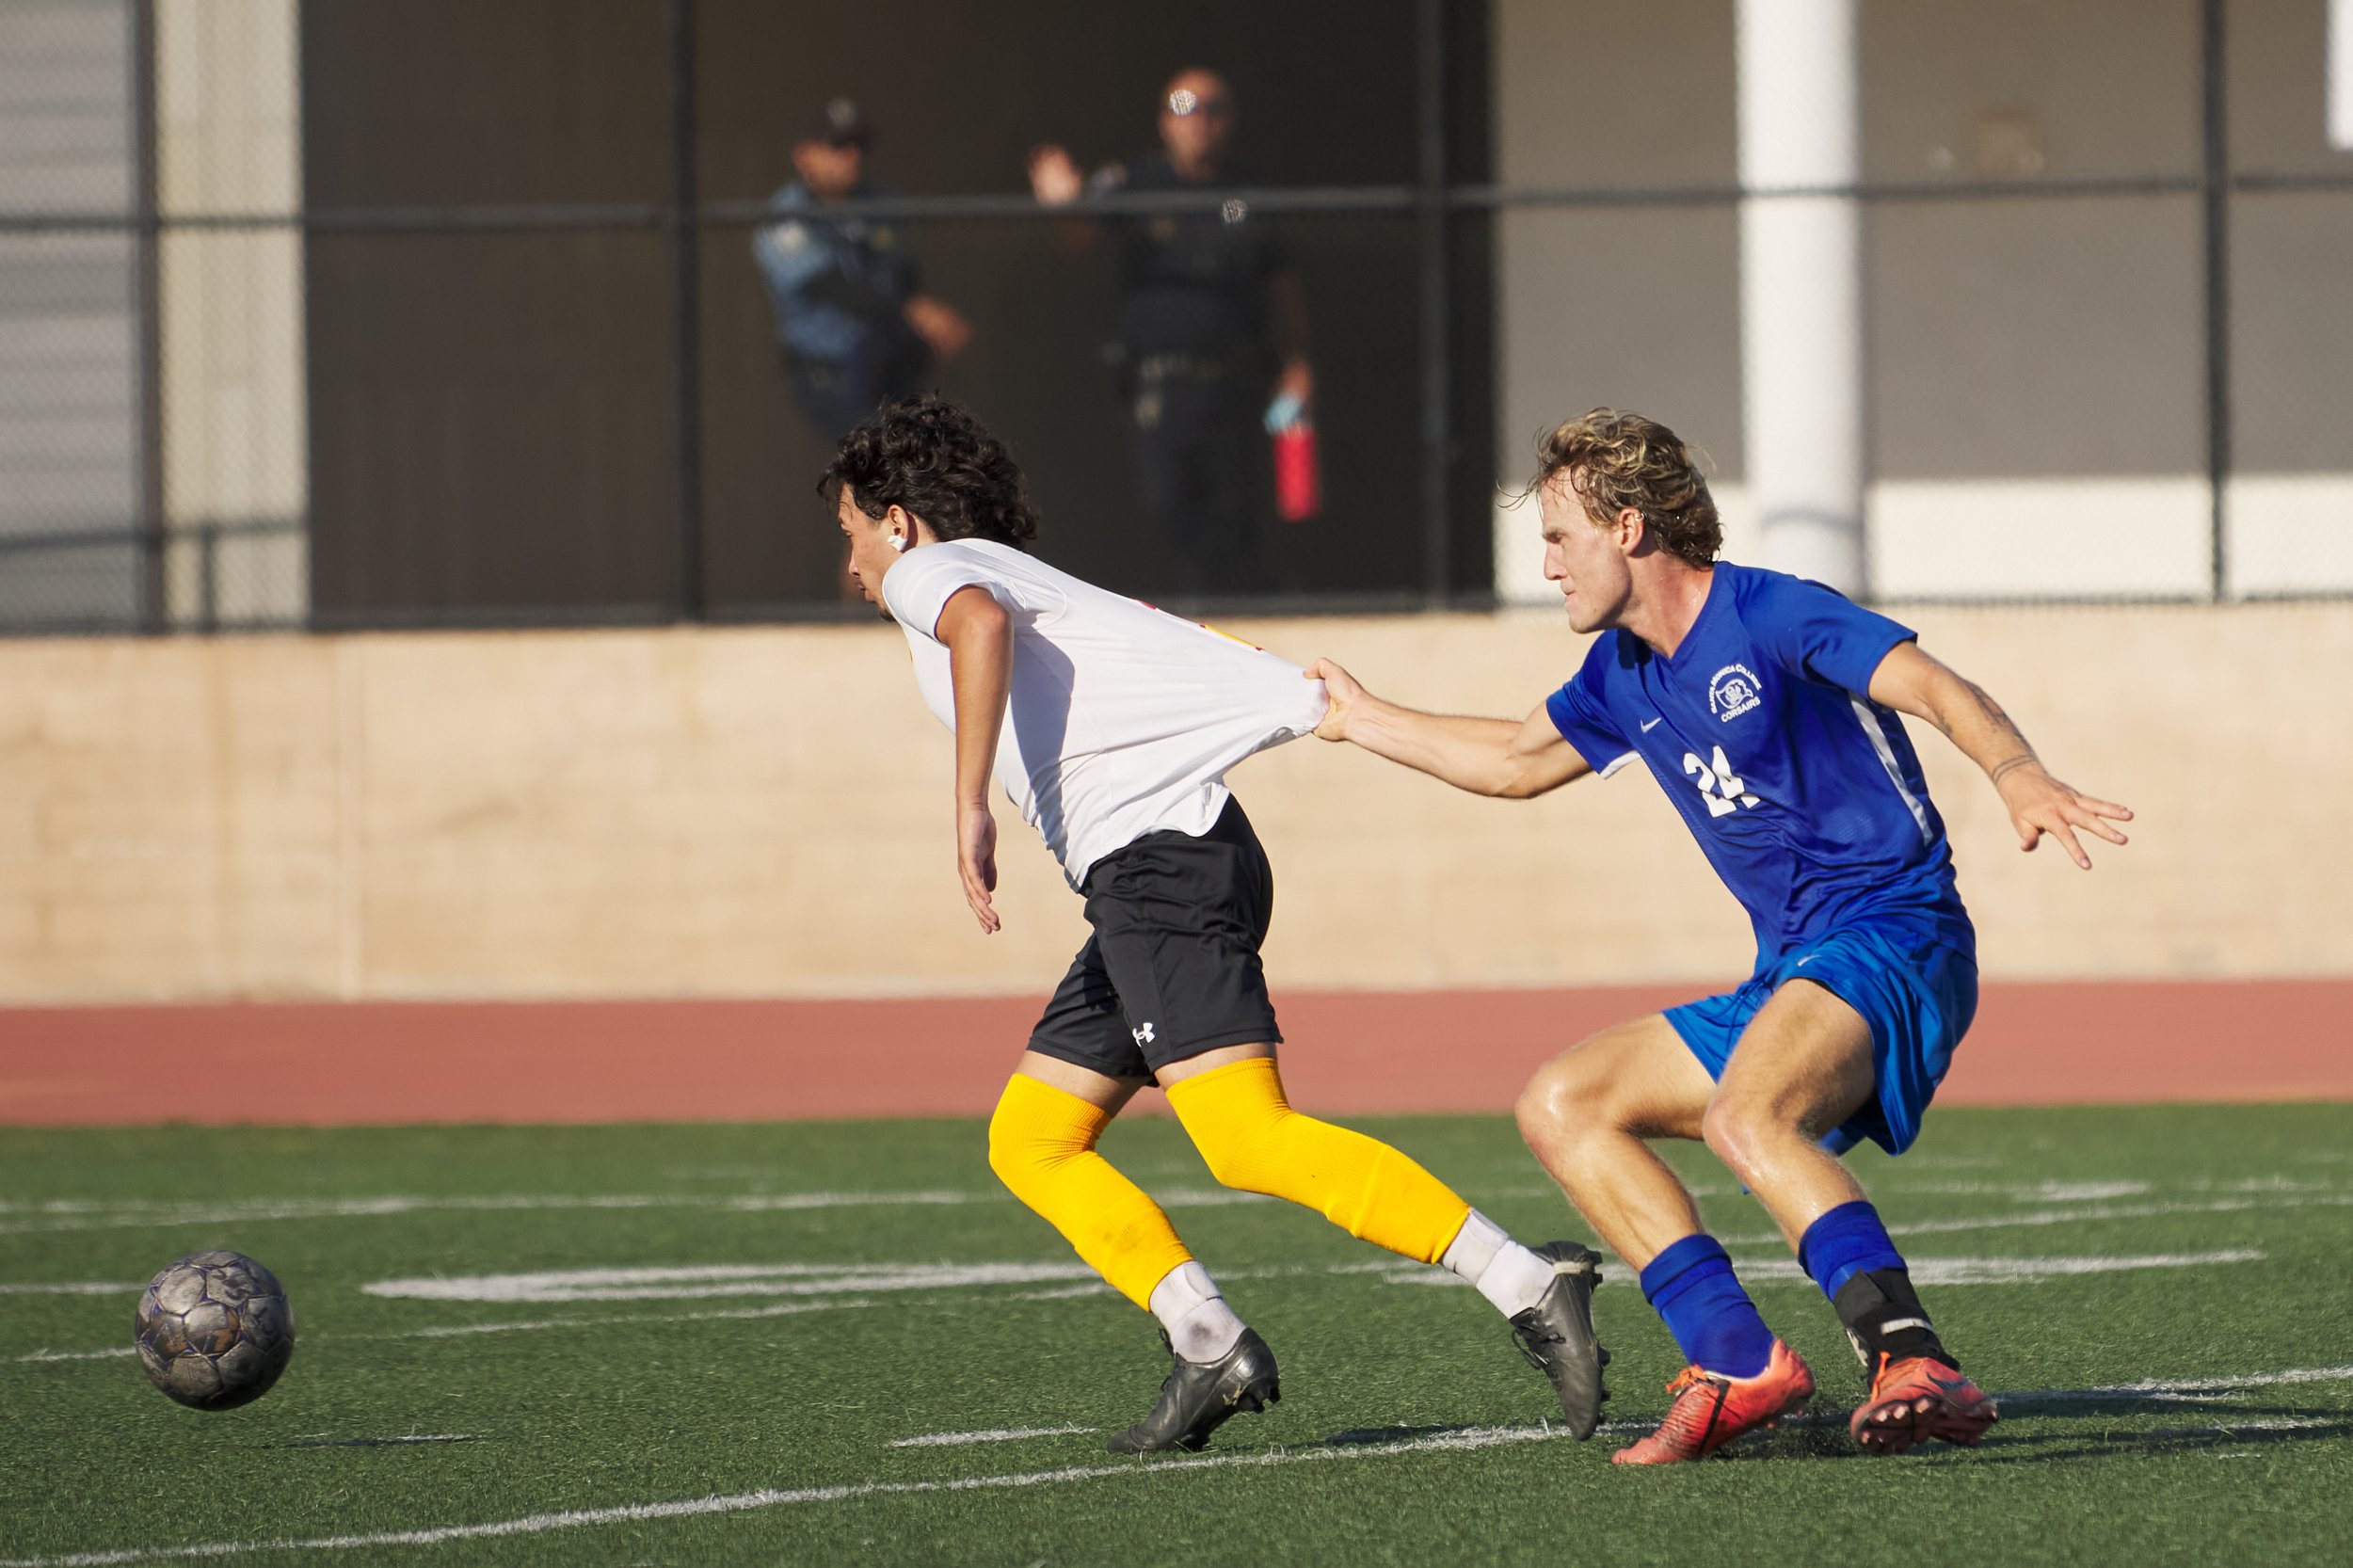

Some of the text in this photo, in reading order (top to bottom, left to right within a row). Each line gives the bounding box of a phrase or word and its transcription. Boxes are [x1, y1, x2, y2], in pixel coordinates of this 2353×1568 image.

[1710, 664, 1736, 687] MONICA
[1721, 696, 1761, 723] CORSAIRS
[1683, 745, 1760, 817] 24
